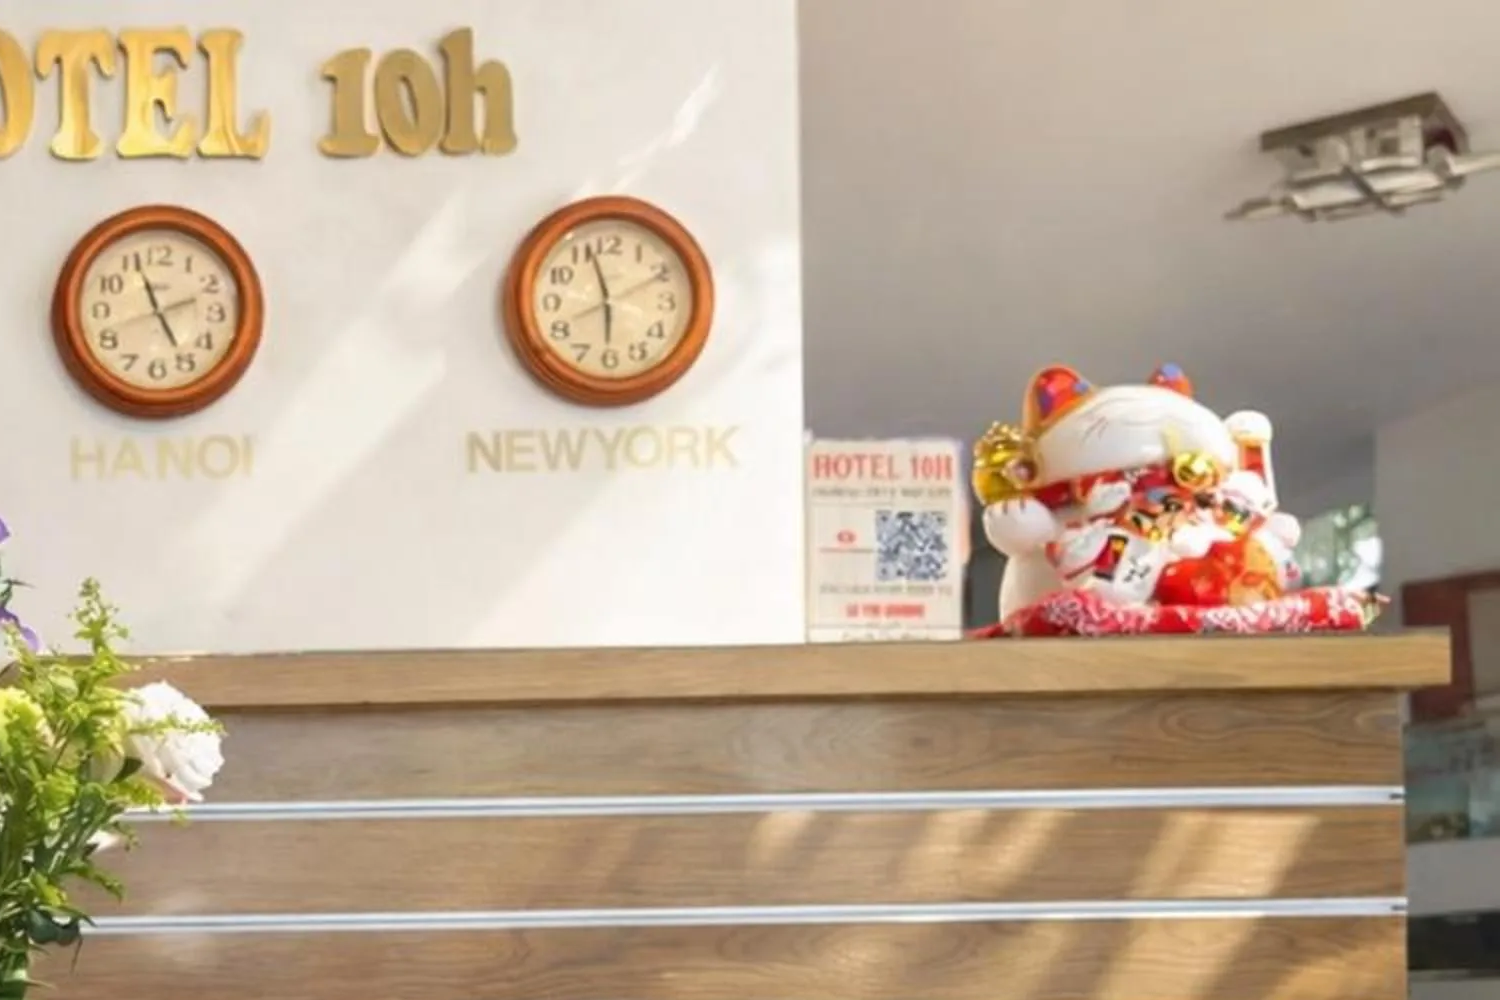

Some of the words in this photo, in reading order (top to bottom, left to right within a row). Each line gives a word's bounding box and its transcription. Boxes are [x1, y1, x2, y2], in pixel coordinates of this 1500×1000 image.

[317, 27, 518, 159] 10h
[596, 236, 622, 255] 12
[636, 244, 642, 263] 1
[147, 245, 173, 267] 12
[184, 255, 193, 273] 1
[550, 265, 574, 285] 10
[650, 264, 670, 283] 2
[98, 275, 123, 295] 10
[200, 274, 220, 294] 2
[657, 292, 677, 312] 3
[205, 303, 226, 323] 3
[98, 329, 118, 350] 8
[550, 320, 571, 340] 8
[647, 321, 665, 340] 4
[195, 331, 213, 351] 4
[570, 343, 592, 362] 7
[601, 349, 620, 370] 6
[628, 342, 648, 361] 5
[120, 354, 140, 372] 7
[148, 359, 167, 380] 6
[175, 353, 196, 373] 5
[71, 435, 254, 481] HANOI
[813, 454, 898, 480] HOTEL
